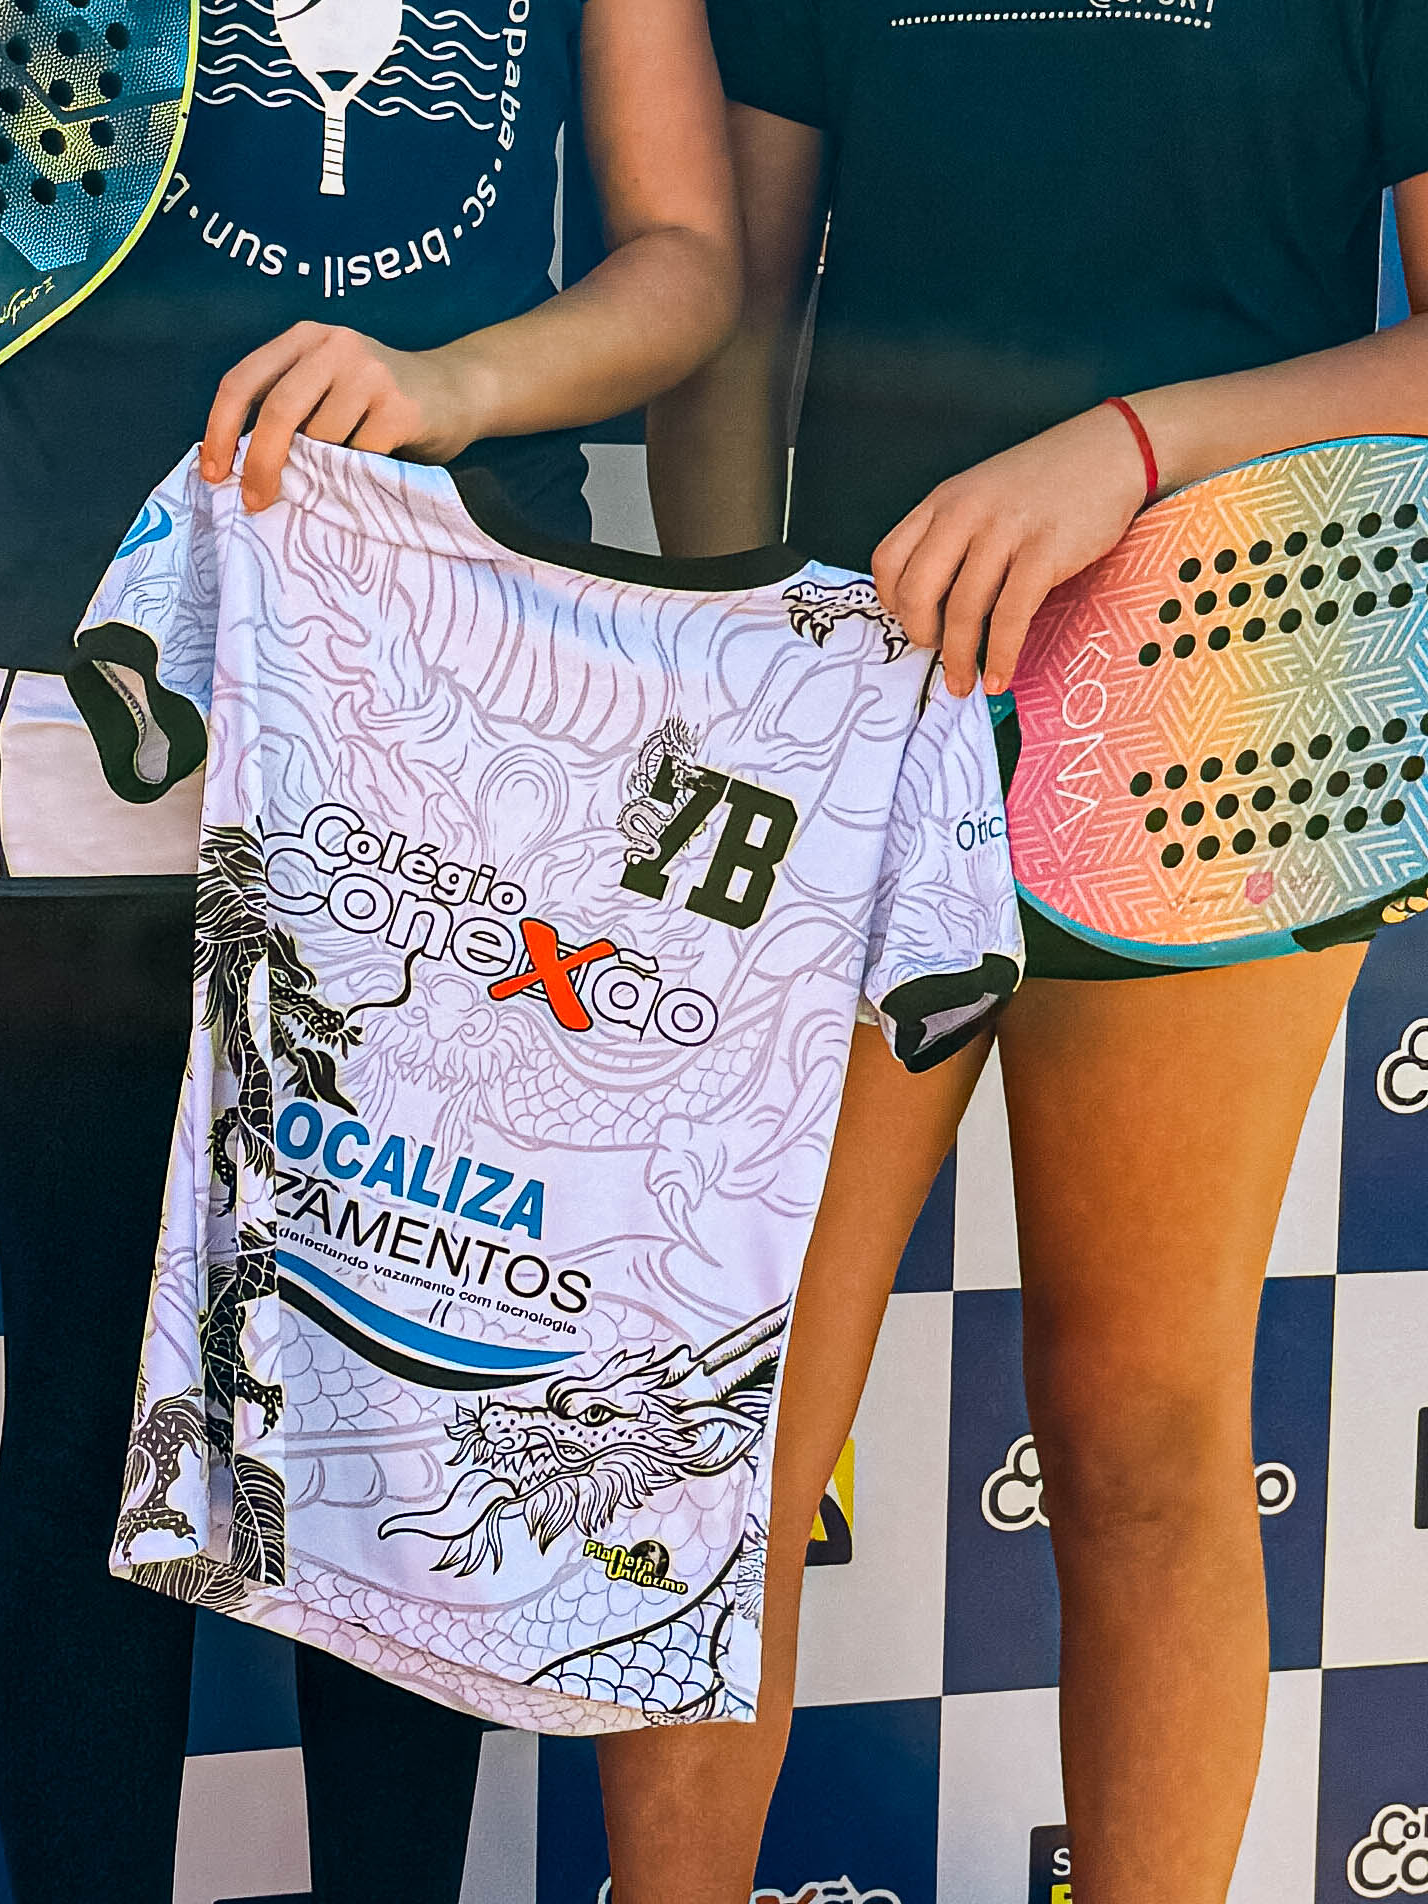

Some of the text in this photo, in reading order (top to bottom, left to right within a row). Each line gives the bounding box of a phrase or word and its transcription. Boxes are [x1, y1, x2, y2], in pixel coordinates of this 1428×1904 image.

[463, 174, 496, 227] sc
[202, 213, 288, 275] sun
[325, 227, 450, 297] brasil
[300, 803, 526, 916] Colégio
[620, 756, 798, 930] 7B
[956, 811, 1007, 851] Ótic
[275, 1102, 545, 1240] OCALIZA
[274, 1172, 592, 1314] ZAMENTOS
[459, 1291, 491, 1307] com
